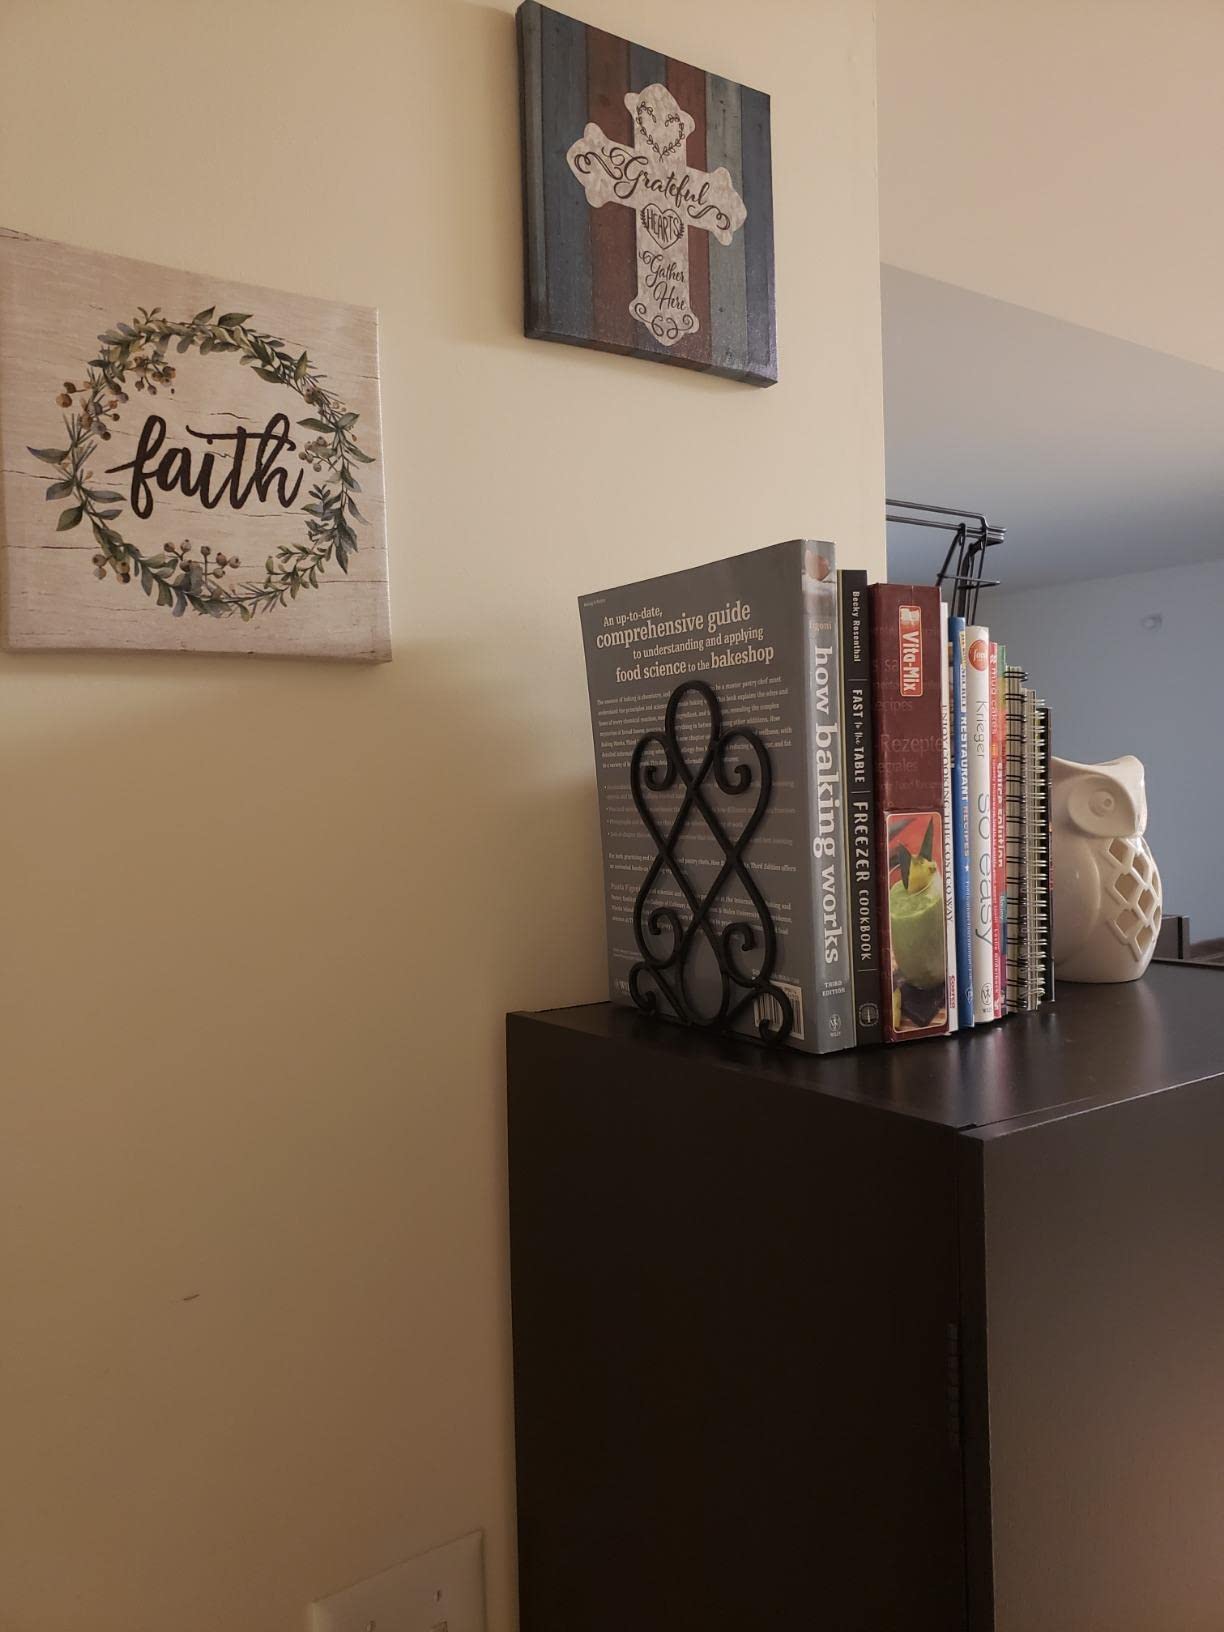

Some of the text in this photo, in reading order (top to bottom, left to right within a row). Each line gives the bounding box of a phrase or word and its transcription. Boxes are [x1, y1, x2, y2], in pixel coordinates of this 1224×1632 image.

[603, 147, 711, 208] Grateful
[646, 210, 681, 244] HEARTS
[639, 251, 685, 288] Gather
[653, 281, 687, 311] Here
[105, 412, 304, 520] faith
[596, 600, 751, 649] comprehensive guide
[603, 607, 663, 627] An up-to-date,
[852, 591, 862, 662] Becky Rosenthal
[615, 646, 774, 683] food science to the bakeshop
[633, 626, 763, 660] to understanding and applying
[902, 631, 921, 691] Vita-Mix
[852, 690, 863, 716] FAST
[853, 731, 866, 746] the
[974, 700, 987, 759] Krieger
[854, 749, 865, 783] TABLE
[960, 716, 969, 802] RESTAURANT
[813, 646, 843, 964] how baking works
[962, 806, 970, 857] RECIPES
[852, 801, 872, 961] FREEZER COOKBOOK
[975, 794, 992, 945] so easy
[946, 899, 955, 922] WAY
[822, 987, 846, 997] EDITION
